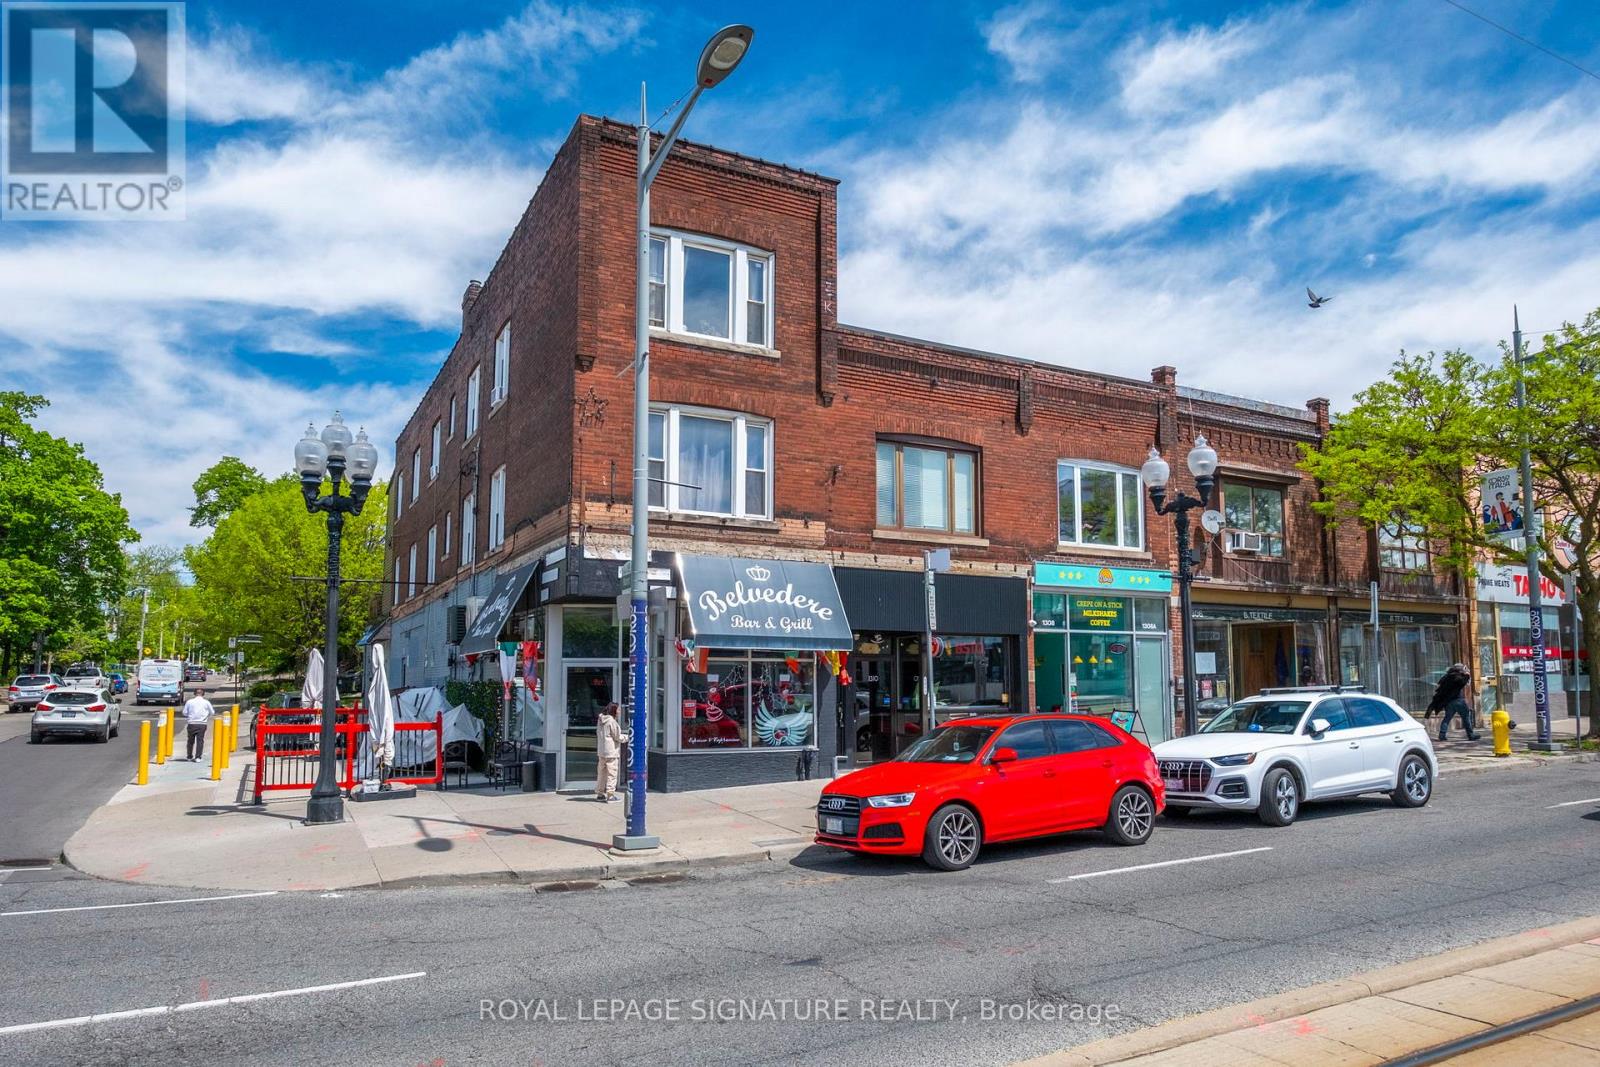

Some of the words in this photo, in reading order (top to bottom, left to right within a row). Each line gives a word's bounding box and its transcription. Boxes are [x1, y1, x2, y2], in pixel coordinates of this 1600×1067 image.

[1494, 580, 1510, 588] MEATS
[699, 580, 833, 621] Belvedere
[731, 614, 761, 628] Bar
[764, 617, 776, 629] &
[780, 617, 813, 633] Grill
[1083, 610, 1117, 618] MILKSHAKES
[1090, 619, 1111, 627] COFFEE
[1531, 610, 1541, 639] CORSO
[1533, 644, 1545, 673] ITALIA
[1535, 675, 1546, 705] CORSO
